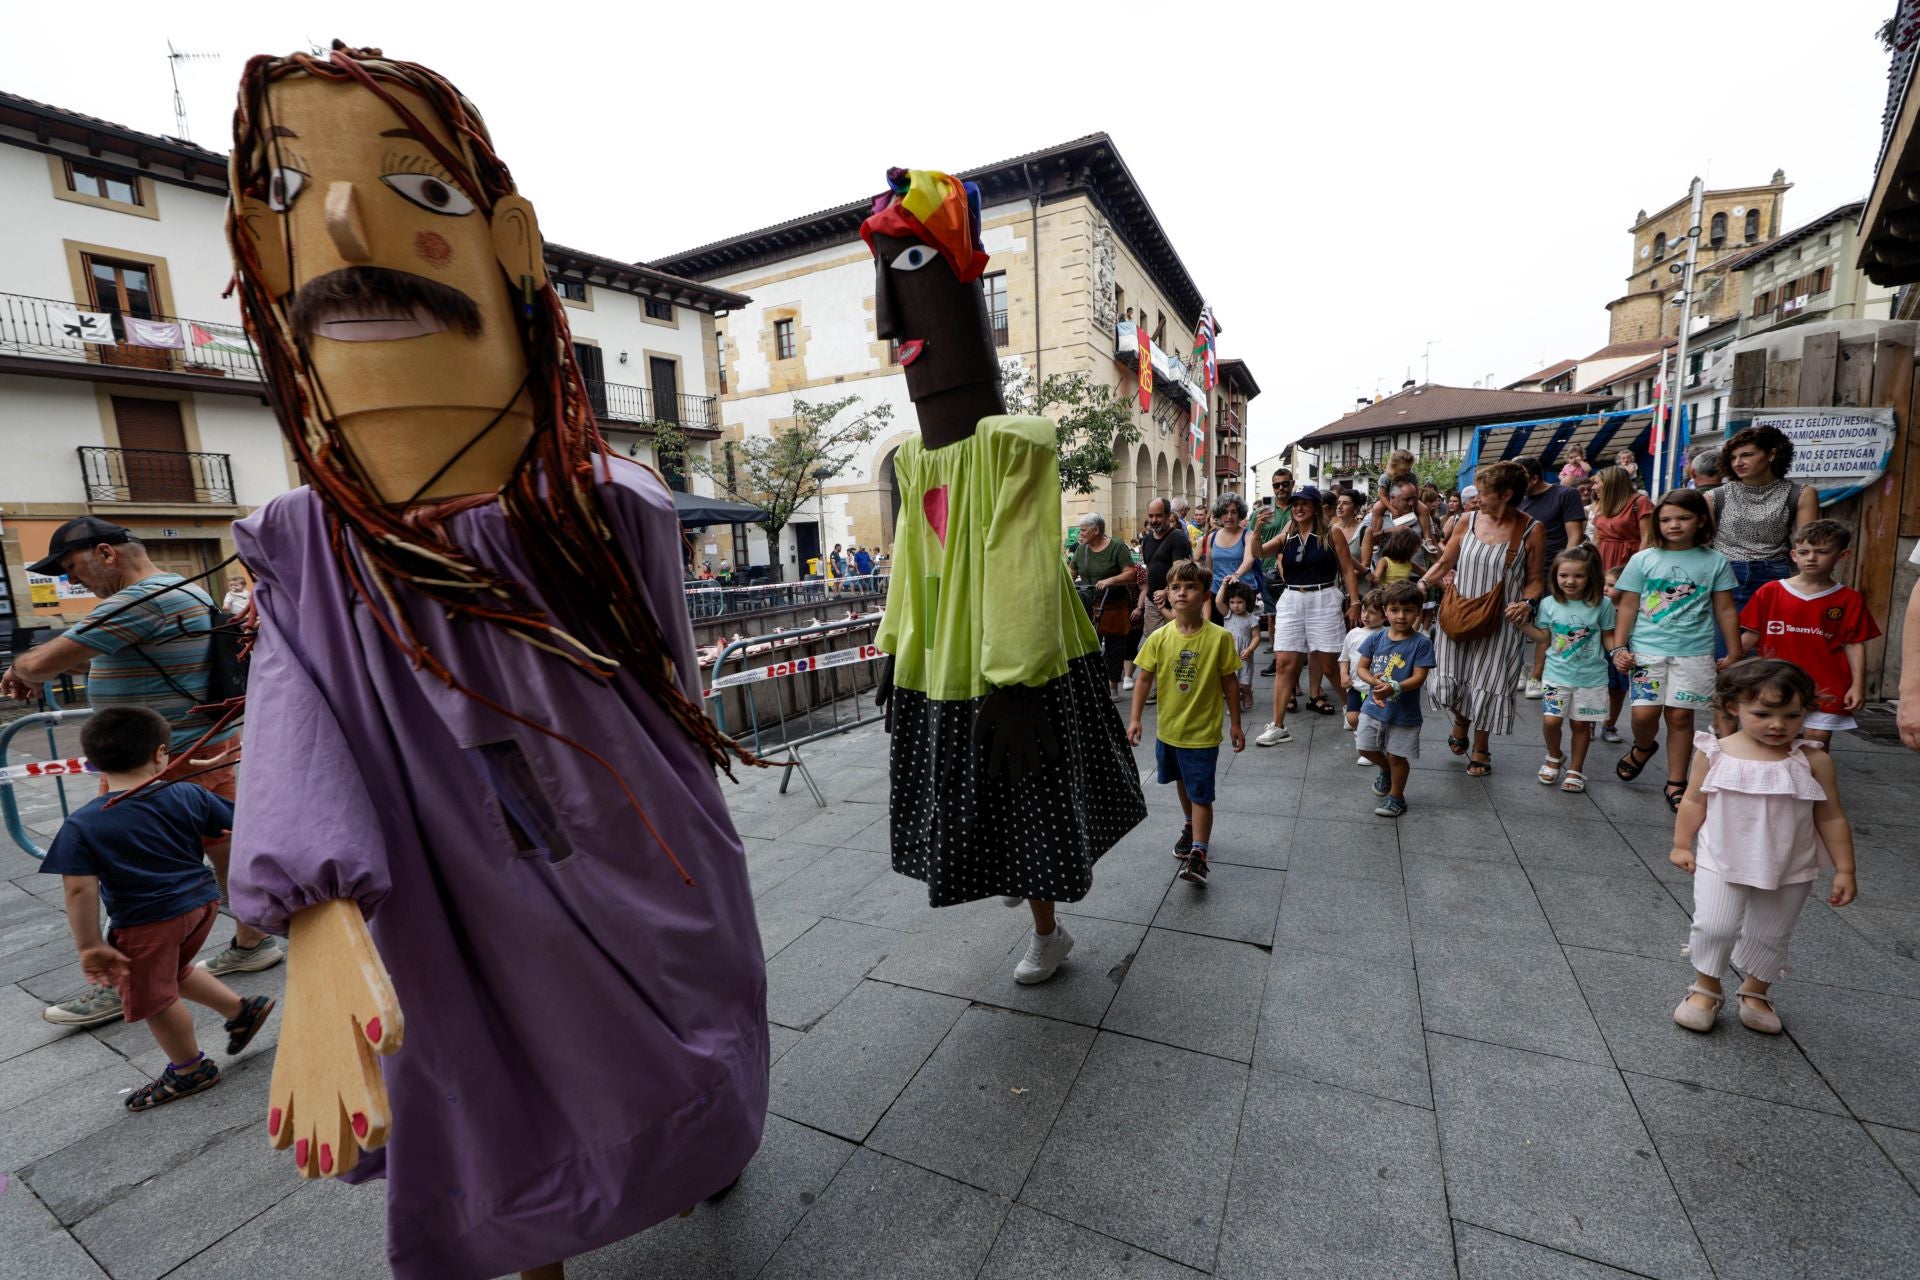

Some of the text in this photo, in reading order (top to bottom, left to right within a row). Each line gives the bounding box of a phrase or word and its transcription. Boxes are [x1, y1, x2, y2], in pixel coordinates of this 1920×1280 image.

[1794, 419, 1804, 428] EZ
[1806, 417, 1841, 428] GELDITU
[1785, 427, 1878, 440] DAMIOAREN ONDOAN
[1799, 450, 1813, 460] NO
[1813, 449, 1825, 460] SE
[1826, 448, 1876, 459] DETENGAN
[1795, 462, 1820, 472] VALLA
[1823, 462, 1831, 472] O
[1786, 624, 1834, 639] TeamVieer
